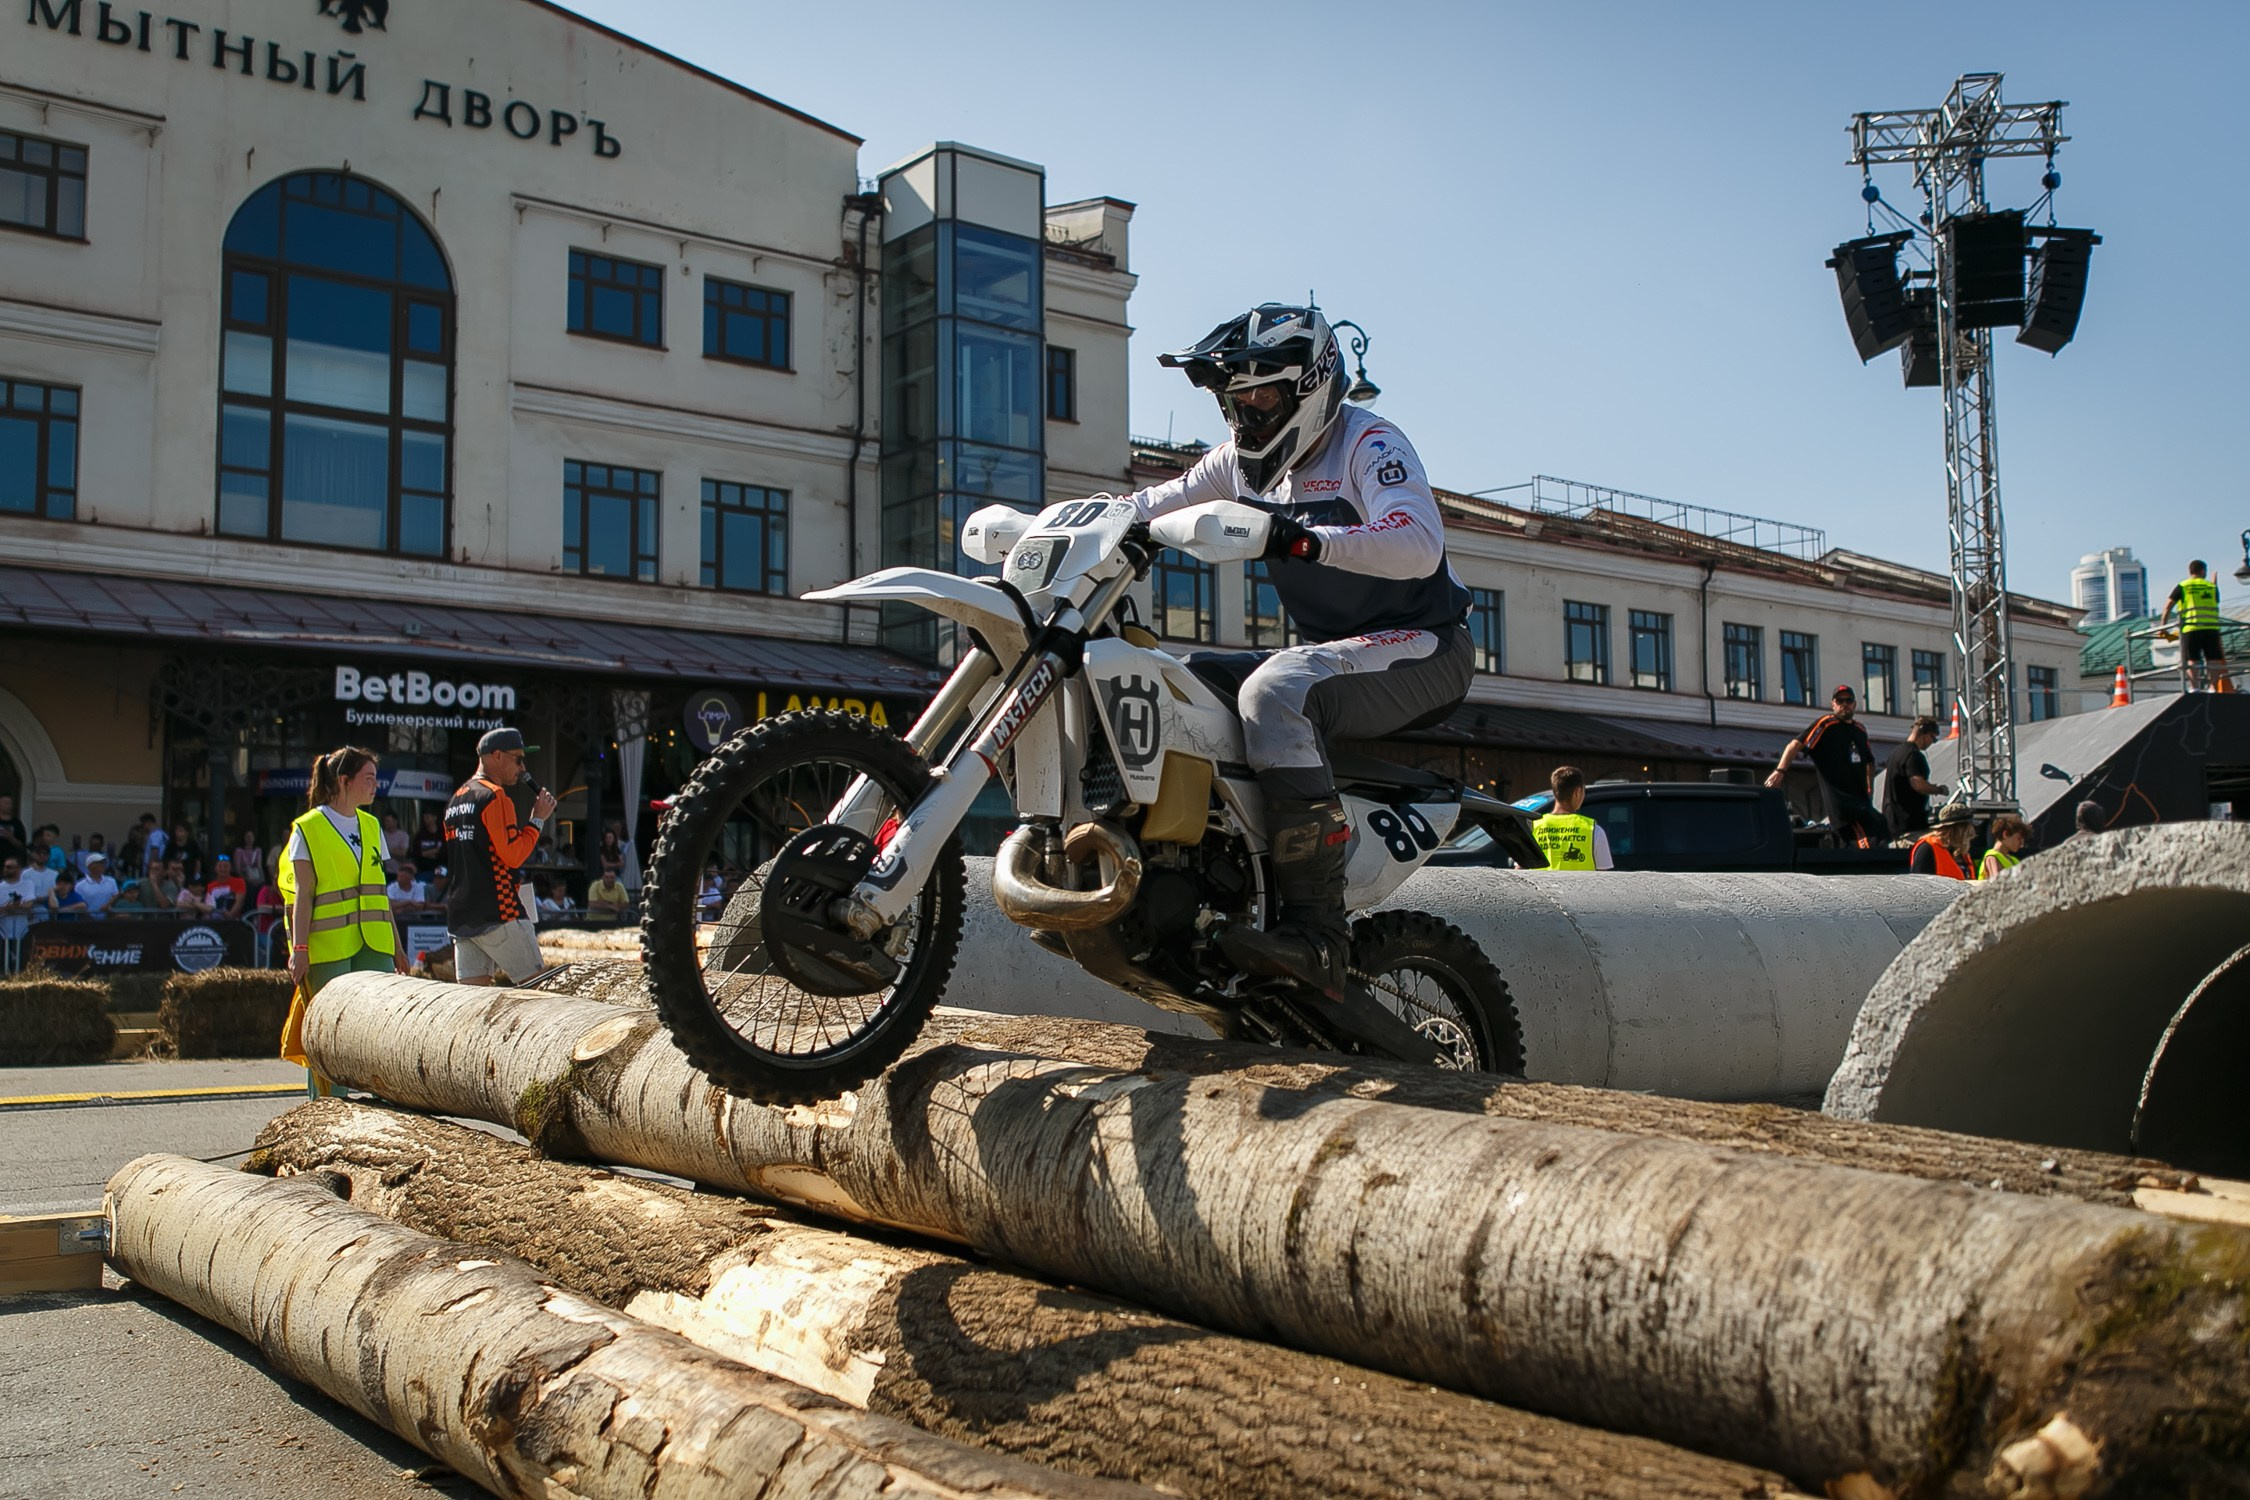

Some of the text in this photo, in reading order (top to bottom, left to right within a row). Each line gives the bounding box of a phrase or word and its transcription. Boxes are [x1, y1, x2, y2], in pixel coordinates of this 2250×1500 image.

[27, 0, 622, 159] МЫТНЫЙ ДВОРЪ
[1043, 502, 1109, 528] 80
[335, 665, 516, 711] BetBoom
[992, 663, 1053, 746] MX-TECH
[345, 707, 463, 730] Букмекерский
[1367, 804, 1440, 863] 80
